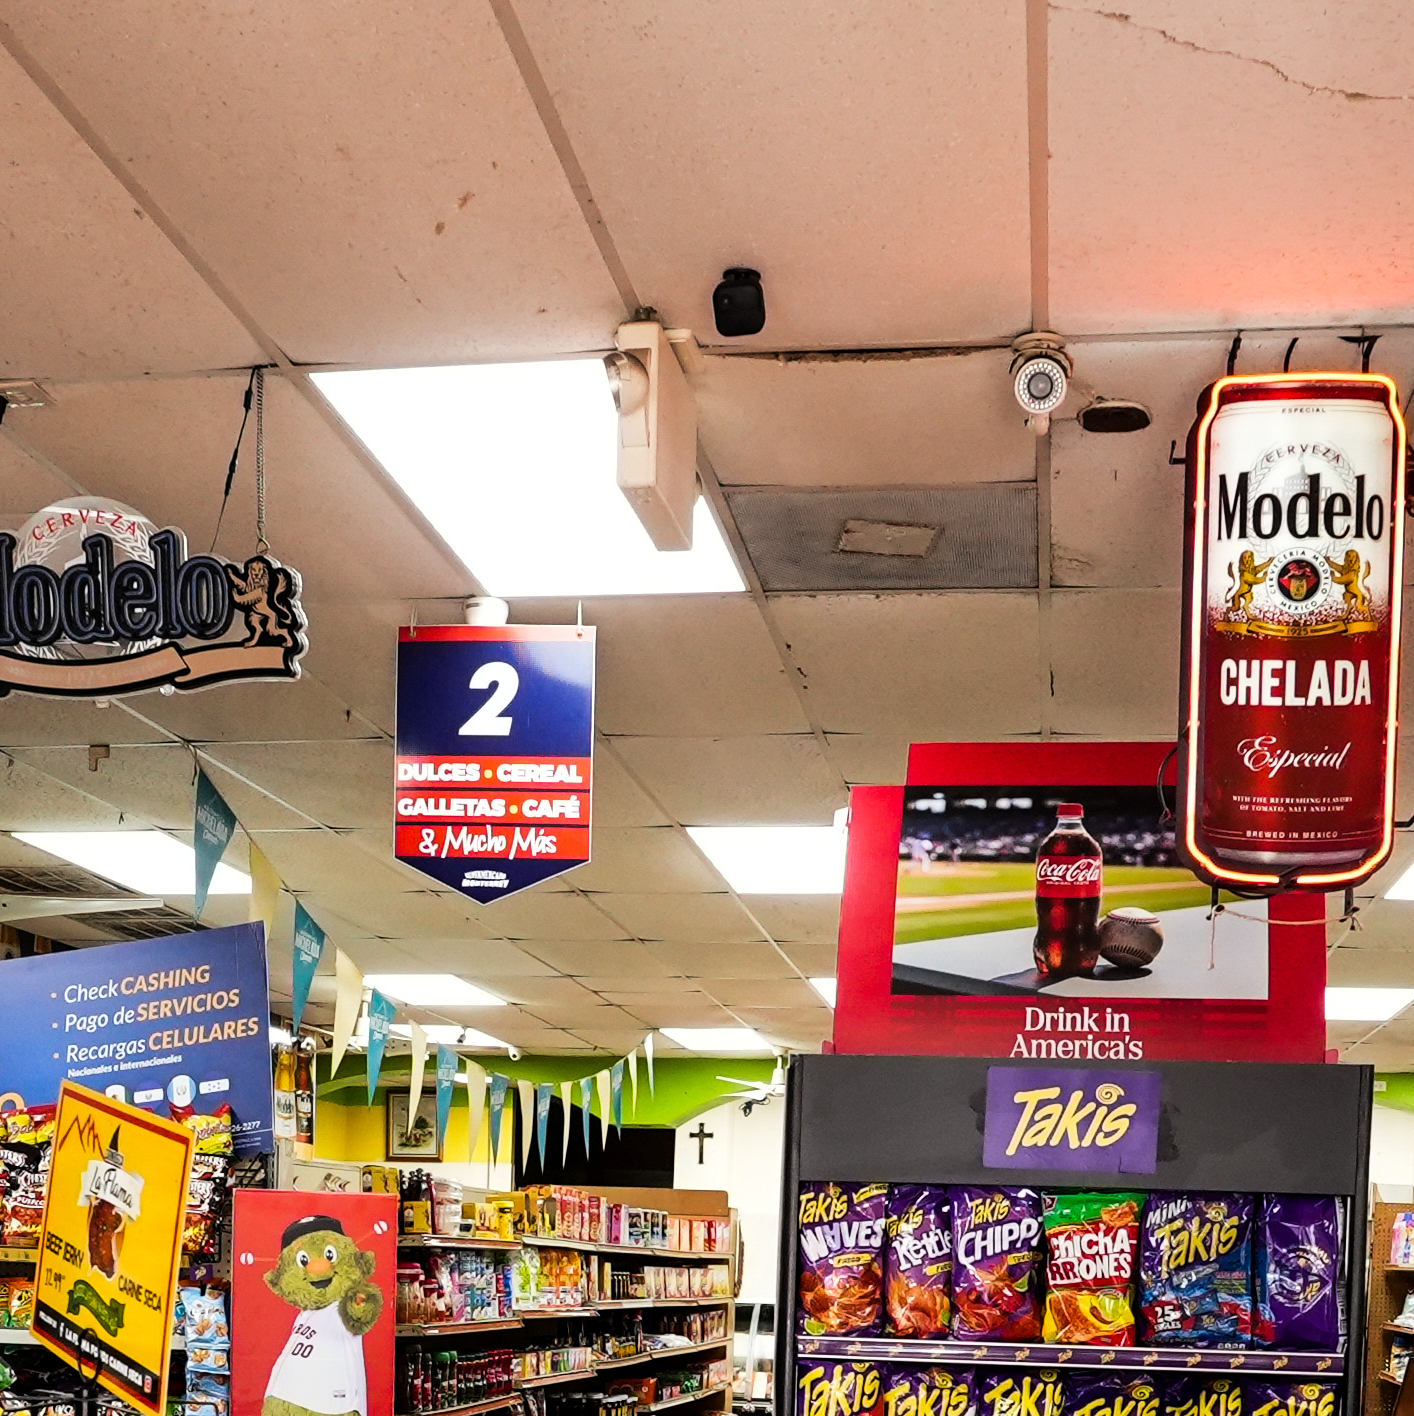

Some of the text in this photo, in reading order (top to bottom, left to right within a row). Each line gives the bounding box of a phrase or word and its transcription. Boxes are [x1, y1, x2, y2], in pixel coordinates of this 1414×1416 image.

[1265, 443, 1341, 464] CERVEZA
[32, 508, 140, 543] CERVEZA
[1216, 471, 1384, 541] Modelo
[457, 660, 520, 737] 2
[1220, 658, 1372, 707] CHELADA
[397, 762, 583, 784] DULCES CEREAL
[1236, 735, 1352, 779] Especial
[397, 794, 581, 819] GALLETAS CAFÉ
[418, 824, 557, 860] & Mucho Más
[1246, 829, 1339, 839] BREWED IN MEXICO
[64, 964, 212, 1004] Check CASHING
[64, 989, 240, 1034] Pago de SERVICIOS
[1024, 1005, 1130, 1034] Drink in
[66, 1016, 260, 1064] Recargas CELULARES
[1009, 1034, 1144, 1062] America's
[67, 1054, 183, 1079] Nacionales internacionales
[1005, 1083, 1139, 1157] Takis
[90, 1165, 134, 1209] La Flama
[798, 1186, 848, 1228] Takis
[45, 1231, 85, 1270] BEEF JERKY
[800, 1218, 887, 1264] WAVES
[1154, 1202, 1239, 1280] Takis
[118, 1274, 143, 1304] CARNE
[143, 1285, 163, 1313] SECA
